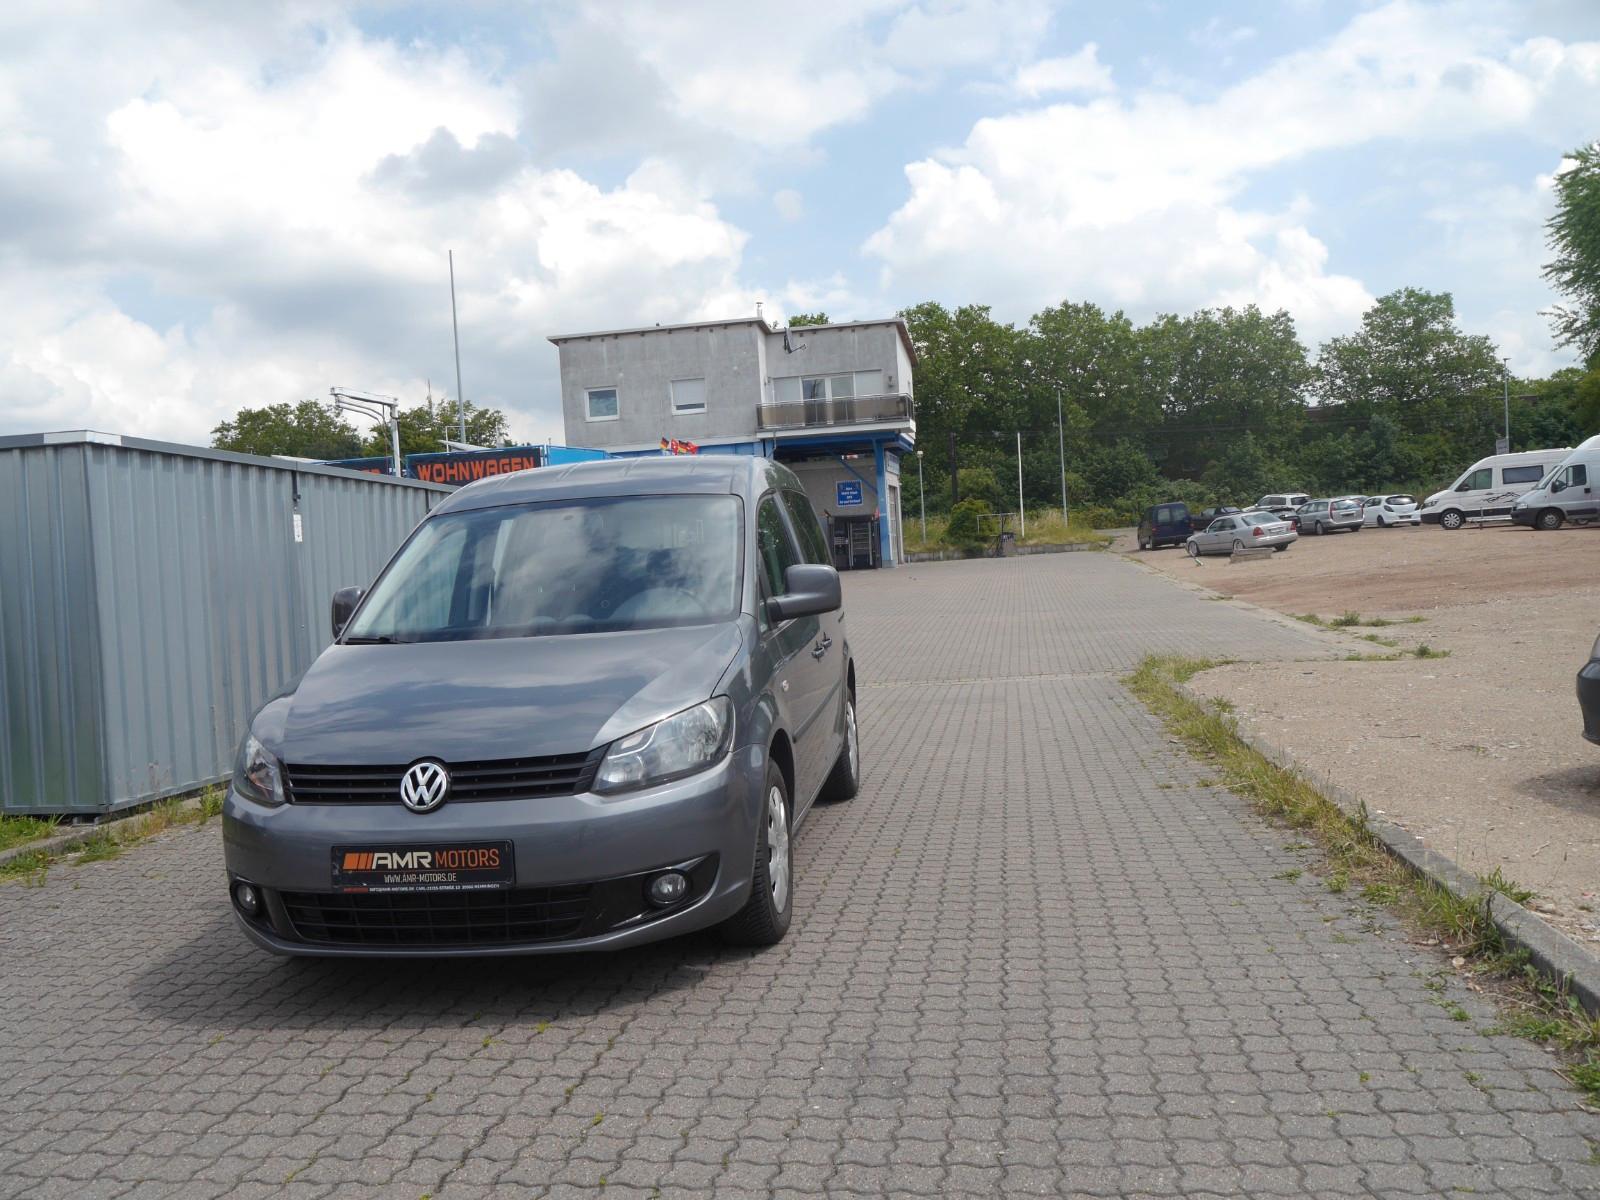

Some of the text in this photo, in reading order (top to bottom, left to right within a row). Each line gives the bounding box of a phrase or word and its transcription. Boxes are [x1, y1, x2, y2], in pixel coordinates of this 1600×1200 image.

[417, 456, 534, 483] WOHNWAGEN
[372, 848, 500, 870] AMR MOTORS
[384, 872, 457, 883] WWW.AMR-MOTORS.DE
